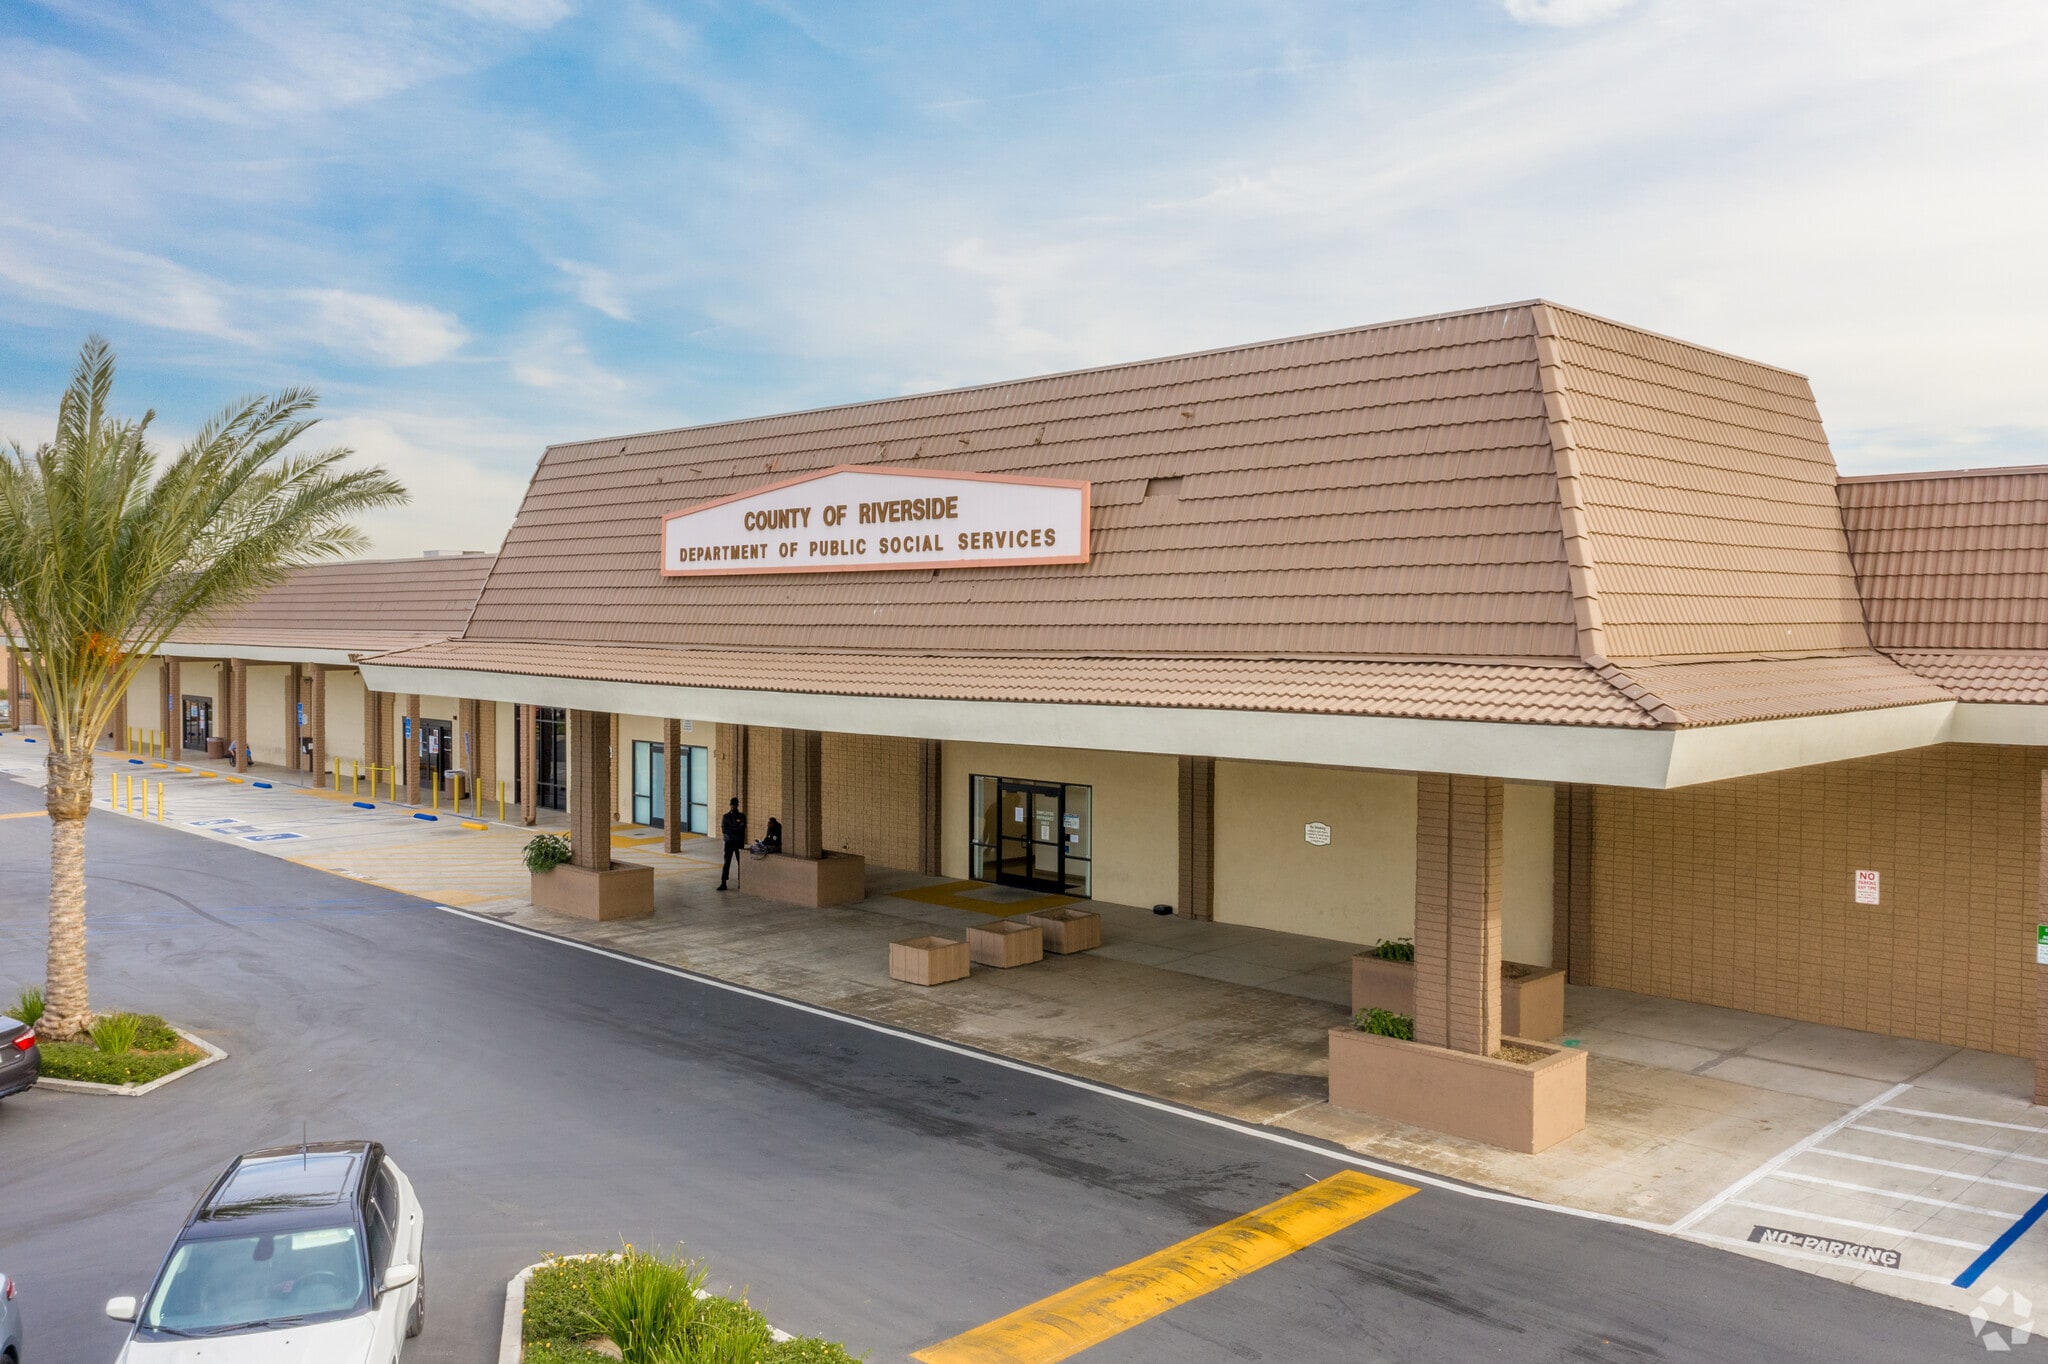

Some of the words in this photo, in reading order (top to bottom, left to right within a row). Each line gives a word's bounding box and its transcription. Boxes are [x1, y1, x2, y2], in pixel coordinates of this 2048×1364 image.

[744, 507, 811, 531] COUNTY
[823, 505, 847, 527] OF
[859, 496, 958, 524] RIVERSIDE
[680, 543, 768, 562] DEPARTMENT
[779, 542, 798, 558] OF
[809, 538, 866, 556] PUBLIC
[879, 534, 944, 554] SOCIAL
[958, 528, 1056, 550] SERVICES
[1860, 872, 1875, 881] NO
[1801, 1236, 1898, 1266] PARKING
